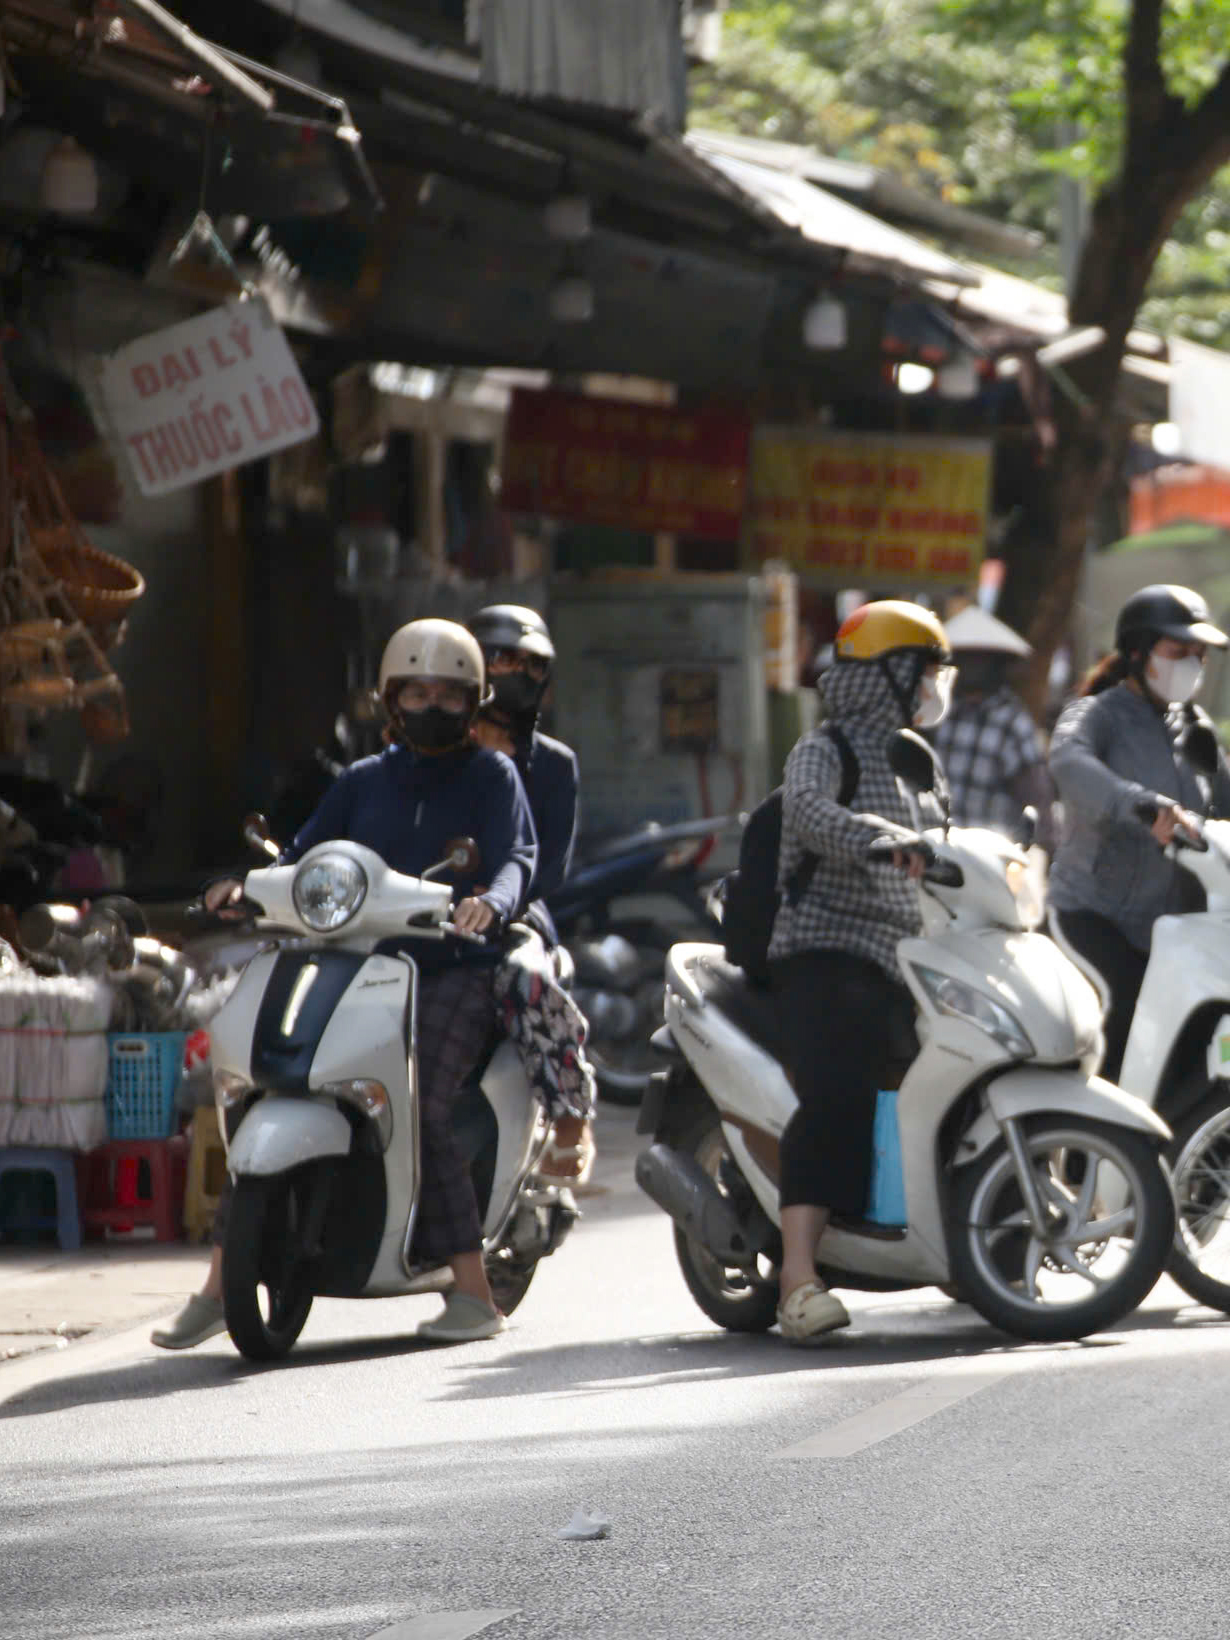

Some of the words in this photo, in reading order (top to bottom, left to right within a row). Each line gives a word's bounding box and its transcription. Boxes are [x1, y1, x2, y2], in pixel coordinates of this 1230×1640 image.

[131, 344, 203, 398] ĐẠI
[207, 318, 253, 368] LÝ
[127, 393, 243, 484] THUỐC
[239, 375, 310, 440] LÀO
